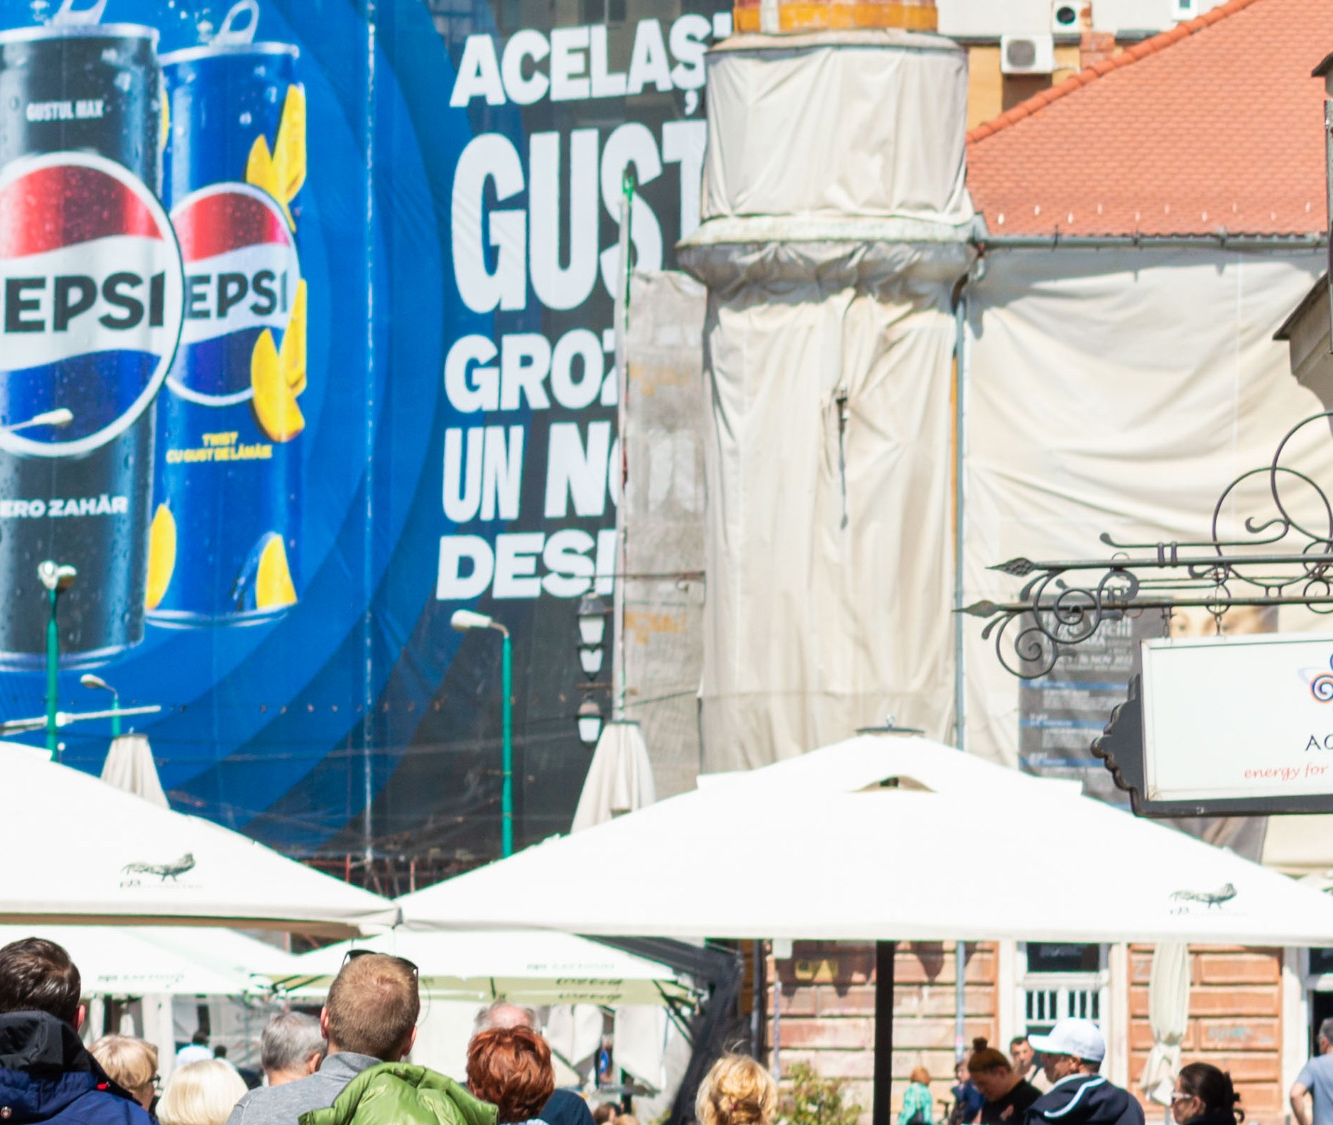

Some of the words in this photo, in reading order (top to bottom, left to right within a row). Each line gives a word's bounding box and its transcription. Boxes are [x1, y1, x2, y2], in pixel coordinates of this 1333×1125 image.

[183, 269, 287, 319] EPSI
[444, 328, 620, 413] GRO
[441, 425, 524, 523] UN
[544, 421, 620, 519] N
[1244, 766, 1300, 781] energy
[1305, 762, 1329, 778] for
